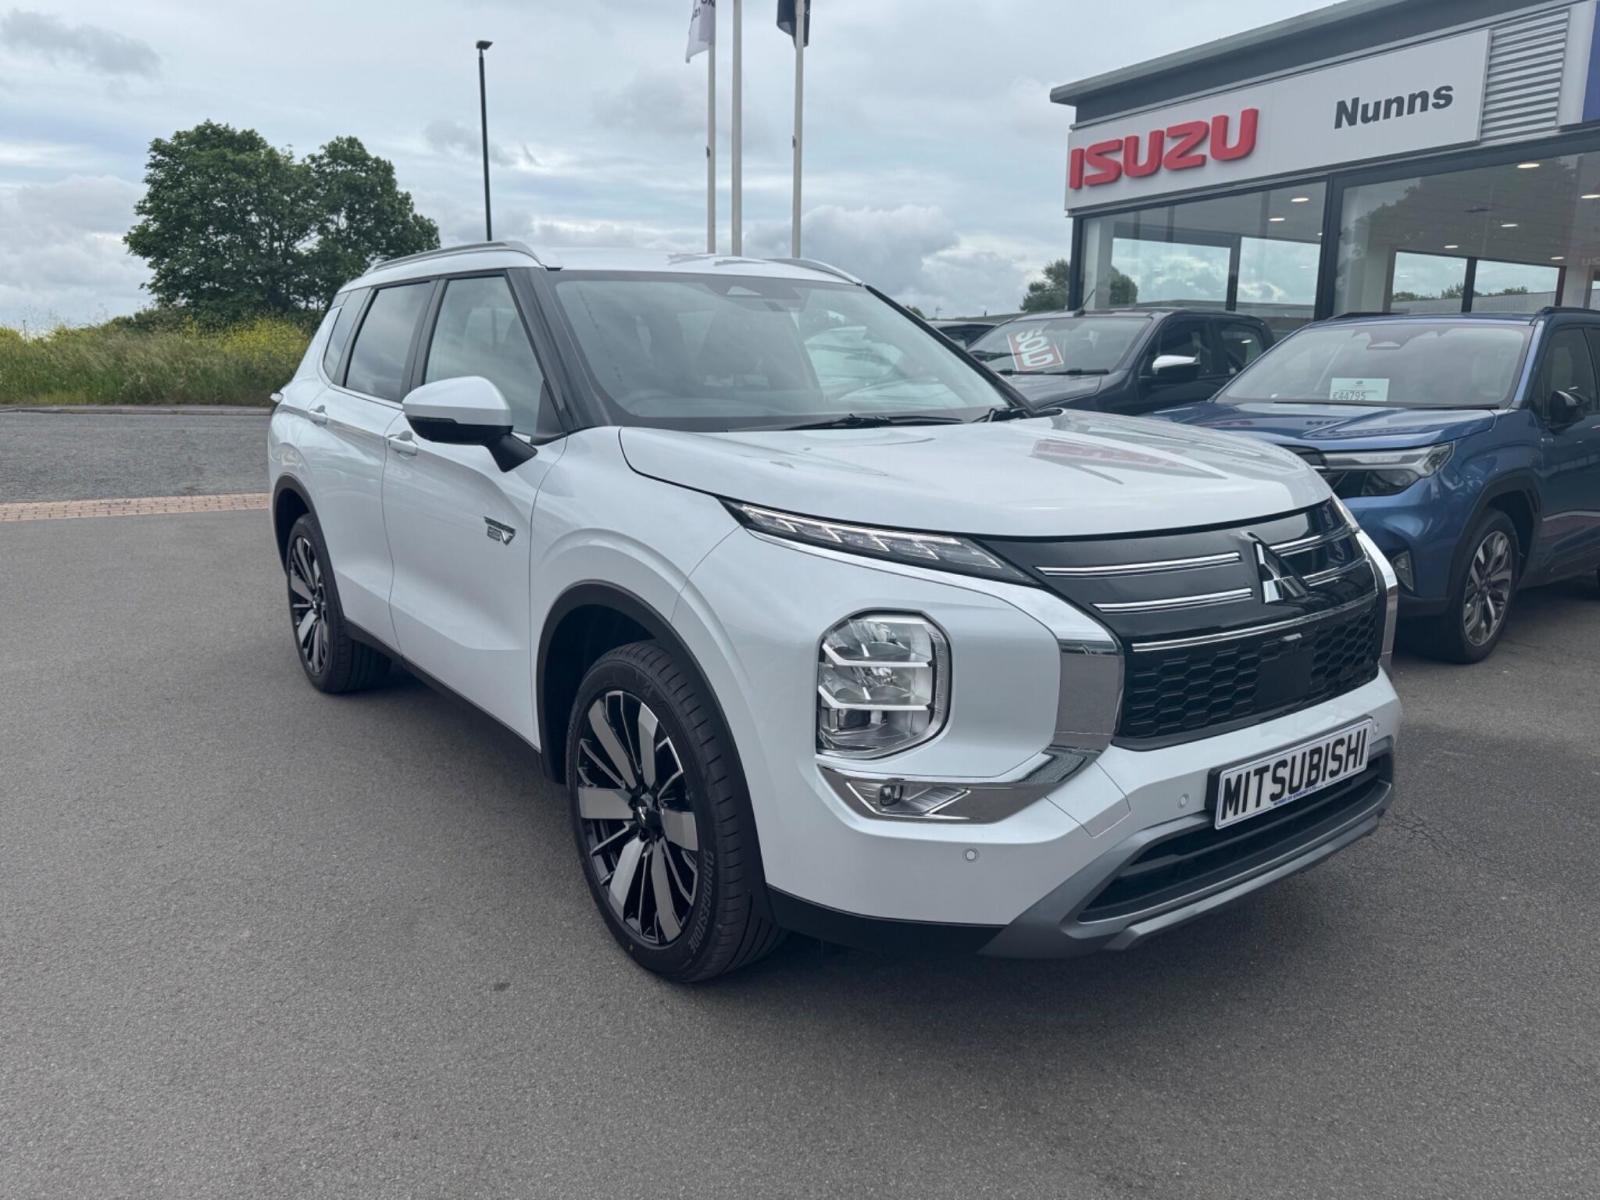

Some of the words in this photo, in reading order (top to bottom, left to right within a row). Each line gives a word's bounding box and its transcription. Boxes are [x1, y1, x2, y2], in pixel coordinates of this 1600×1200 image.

[1334, 85, 1454, 129] Nunns
[1069, 108, 1259, 190] ISUZU
[1015, 329, 1055, 367] SOLD
[1220, 728, 1368, 820] MITSUBISHI
